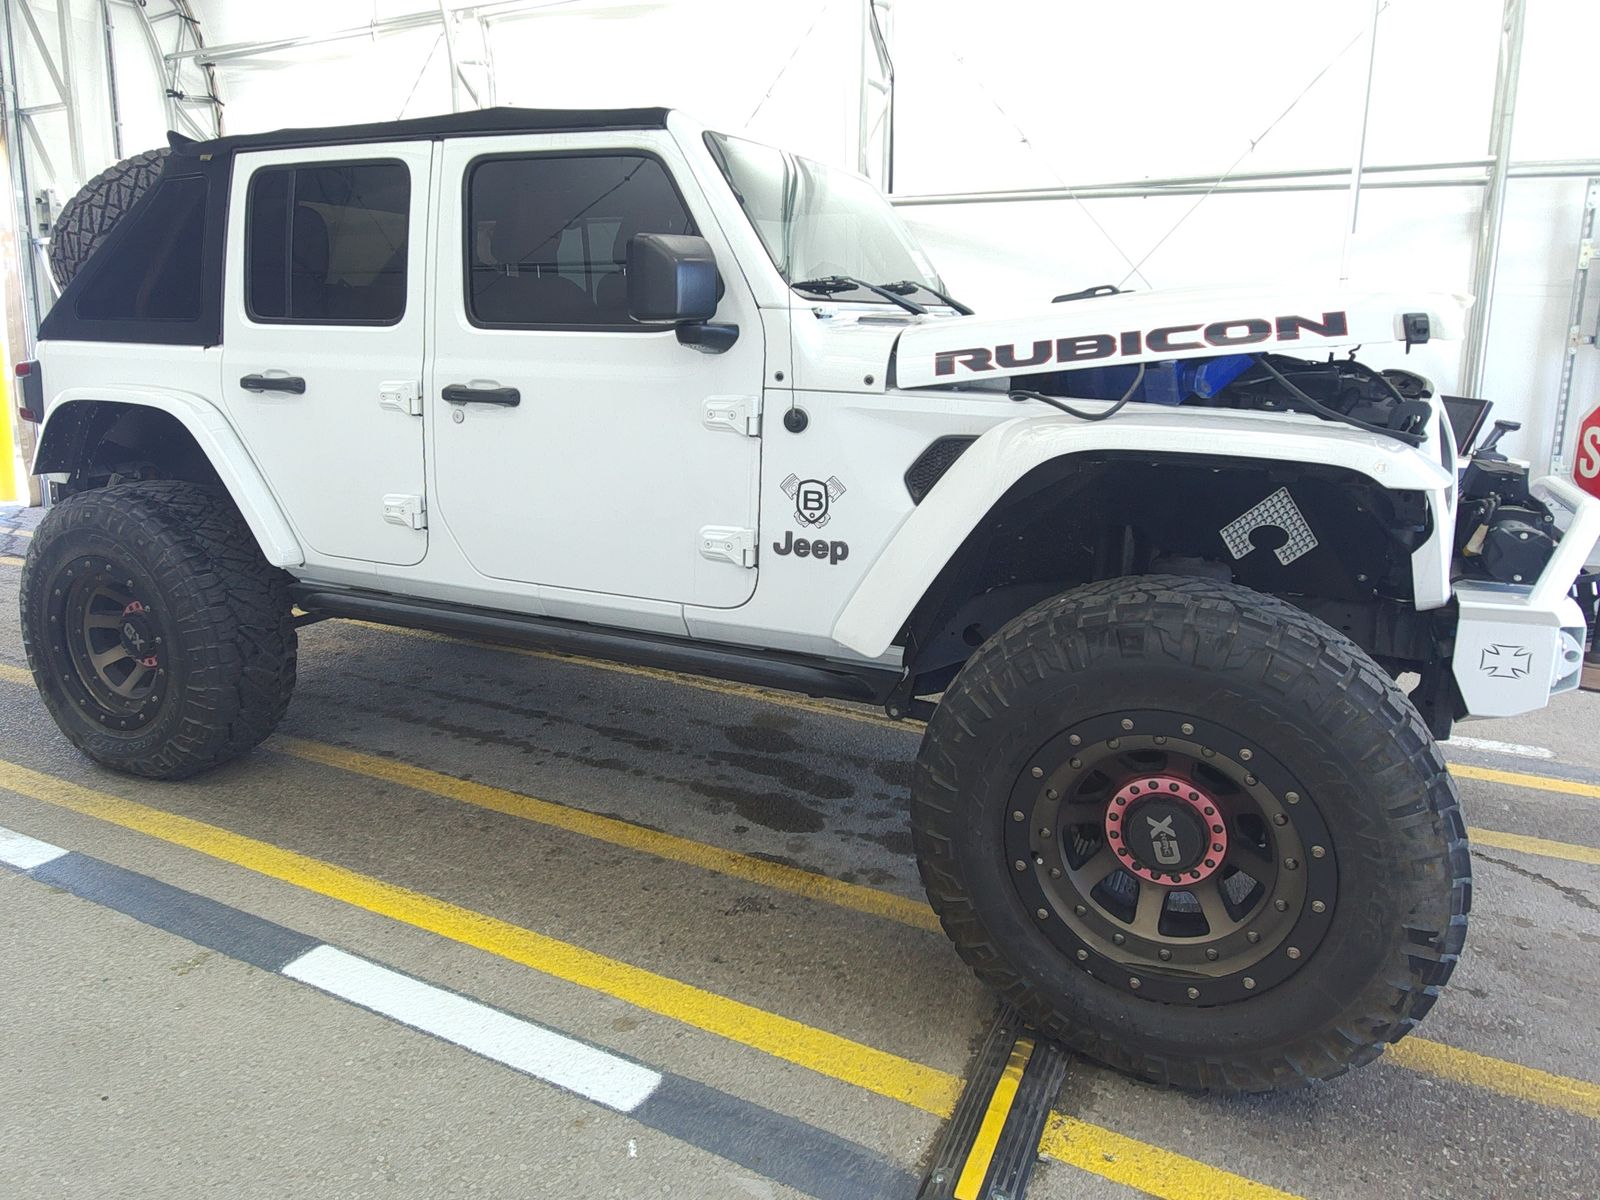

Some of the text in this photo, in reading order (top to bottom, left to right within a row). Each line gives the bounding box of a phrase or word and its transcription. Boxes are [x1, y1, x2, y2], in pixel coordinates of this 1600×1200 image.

[935, 311, 1348, 376] RUBICON
[803, 490, 823, 511] B
[773, 531, 849, 565] Jeep
